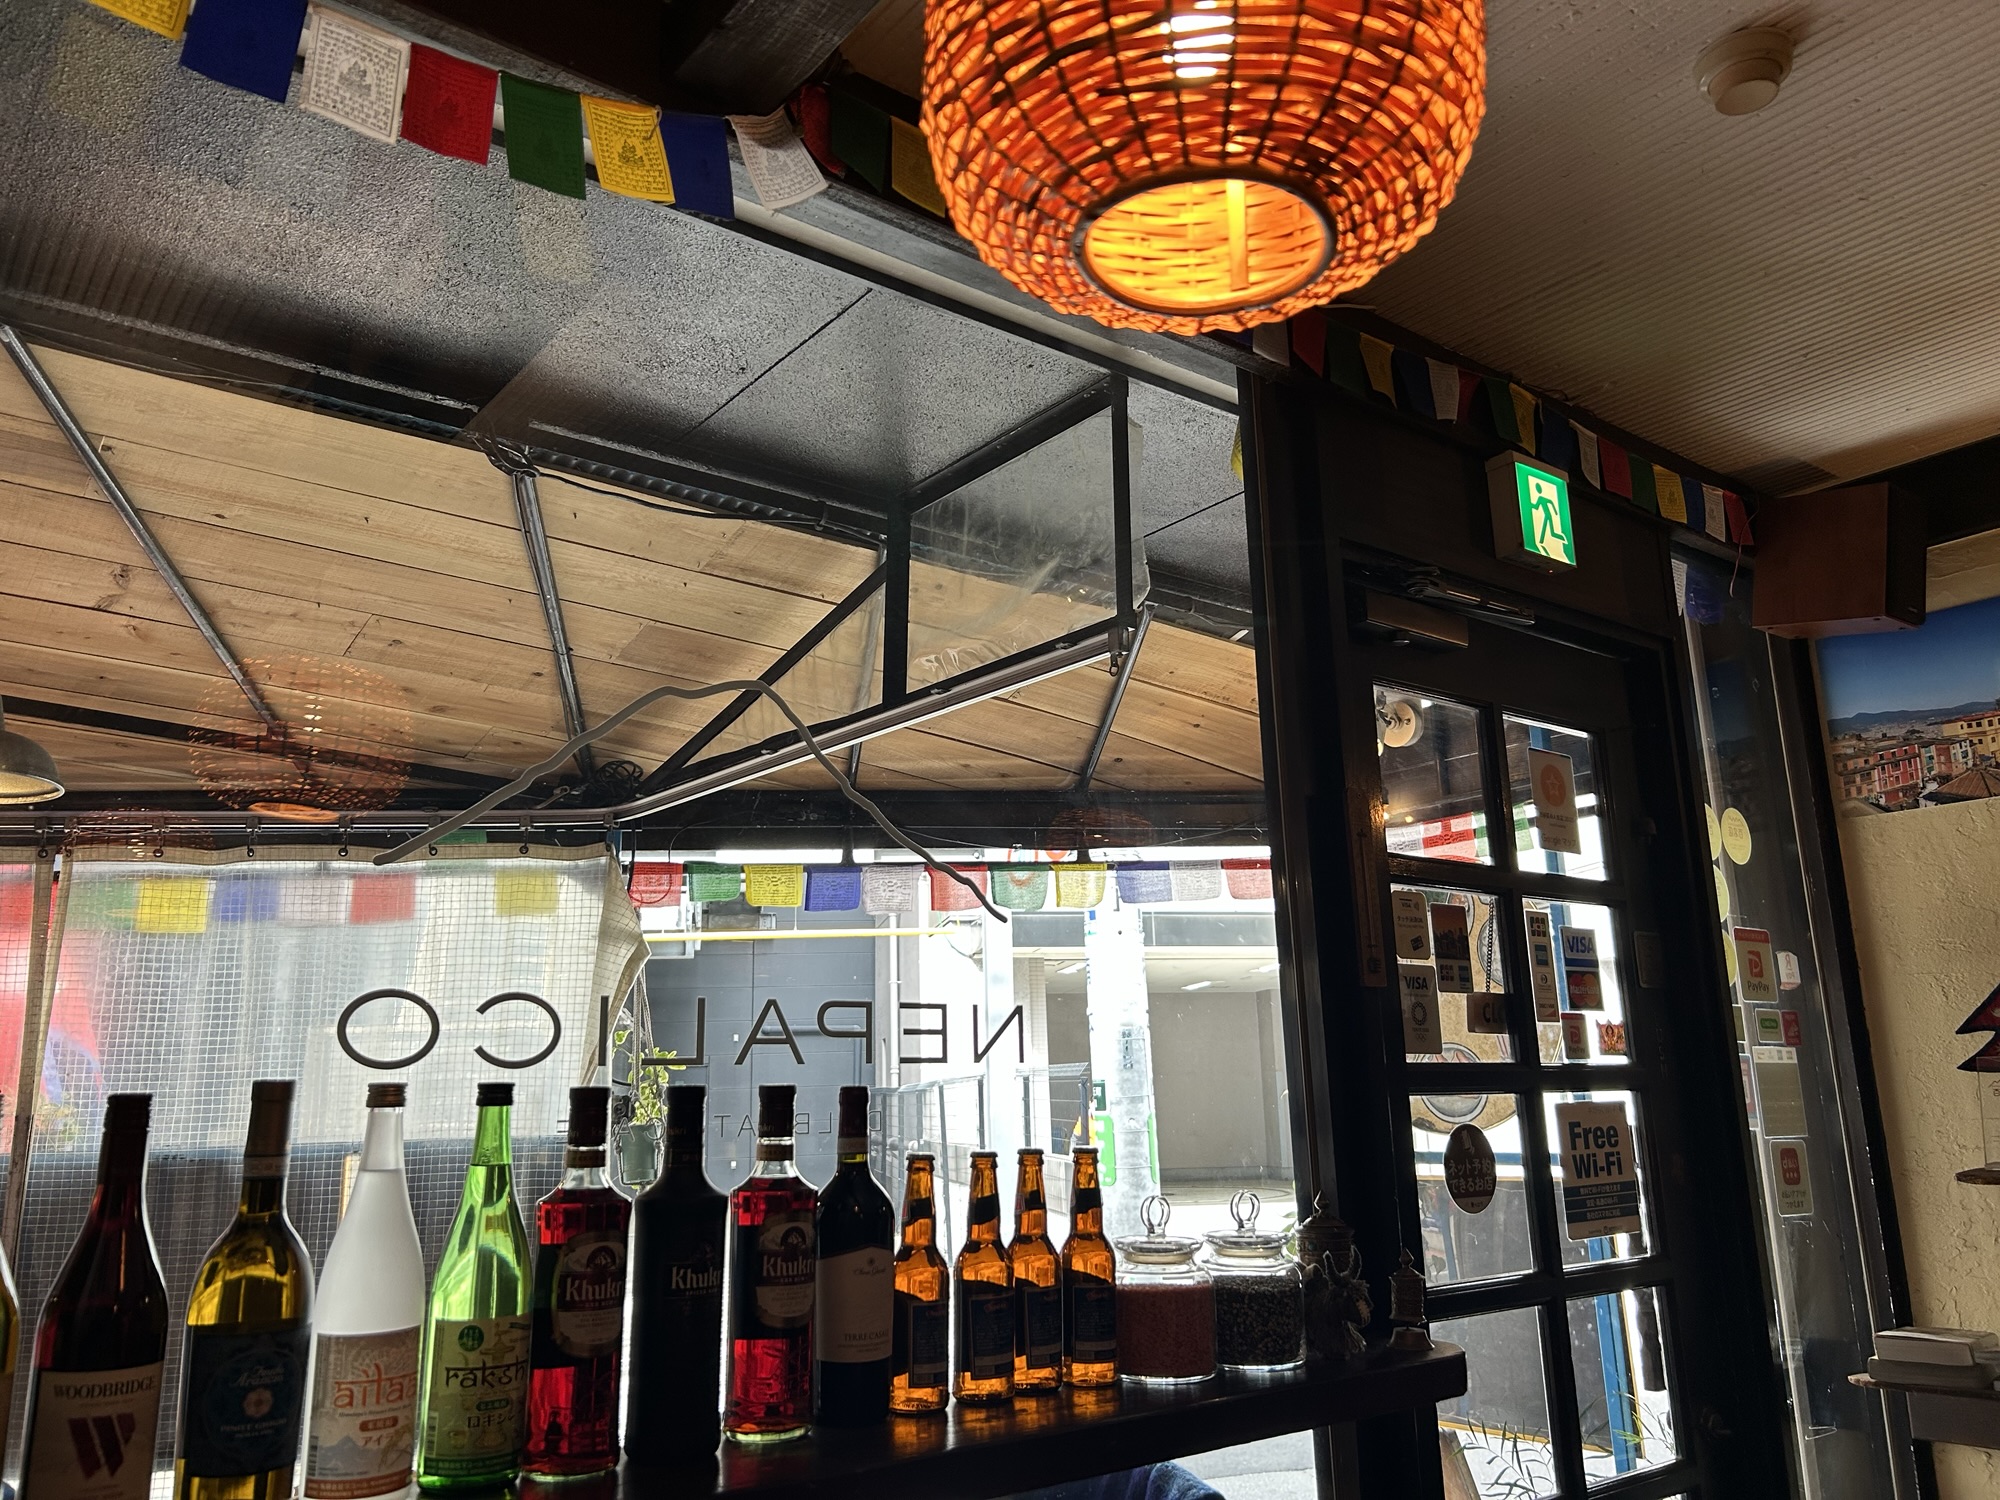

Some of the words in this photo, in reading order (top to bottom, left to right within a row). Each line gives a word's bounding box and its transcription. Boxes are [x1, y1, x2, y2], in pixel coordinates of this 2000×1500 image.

[1566, 936, 1596, 953] VISA
[1403, 976, 1428, 990] VISA
[1747, 980, 1770, 993] PayPay
[1568, 1121, 1619, 1151] Free
[1572, 1151, 1623, 1179] Wi-Fi
[1449, 1176, 1493, 1193] できるお店
[53, 1375, 156, 1400] WOODBRIDGE
